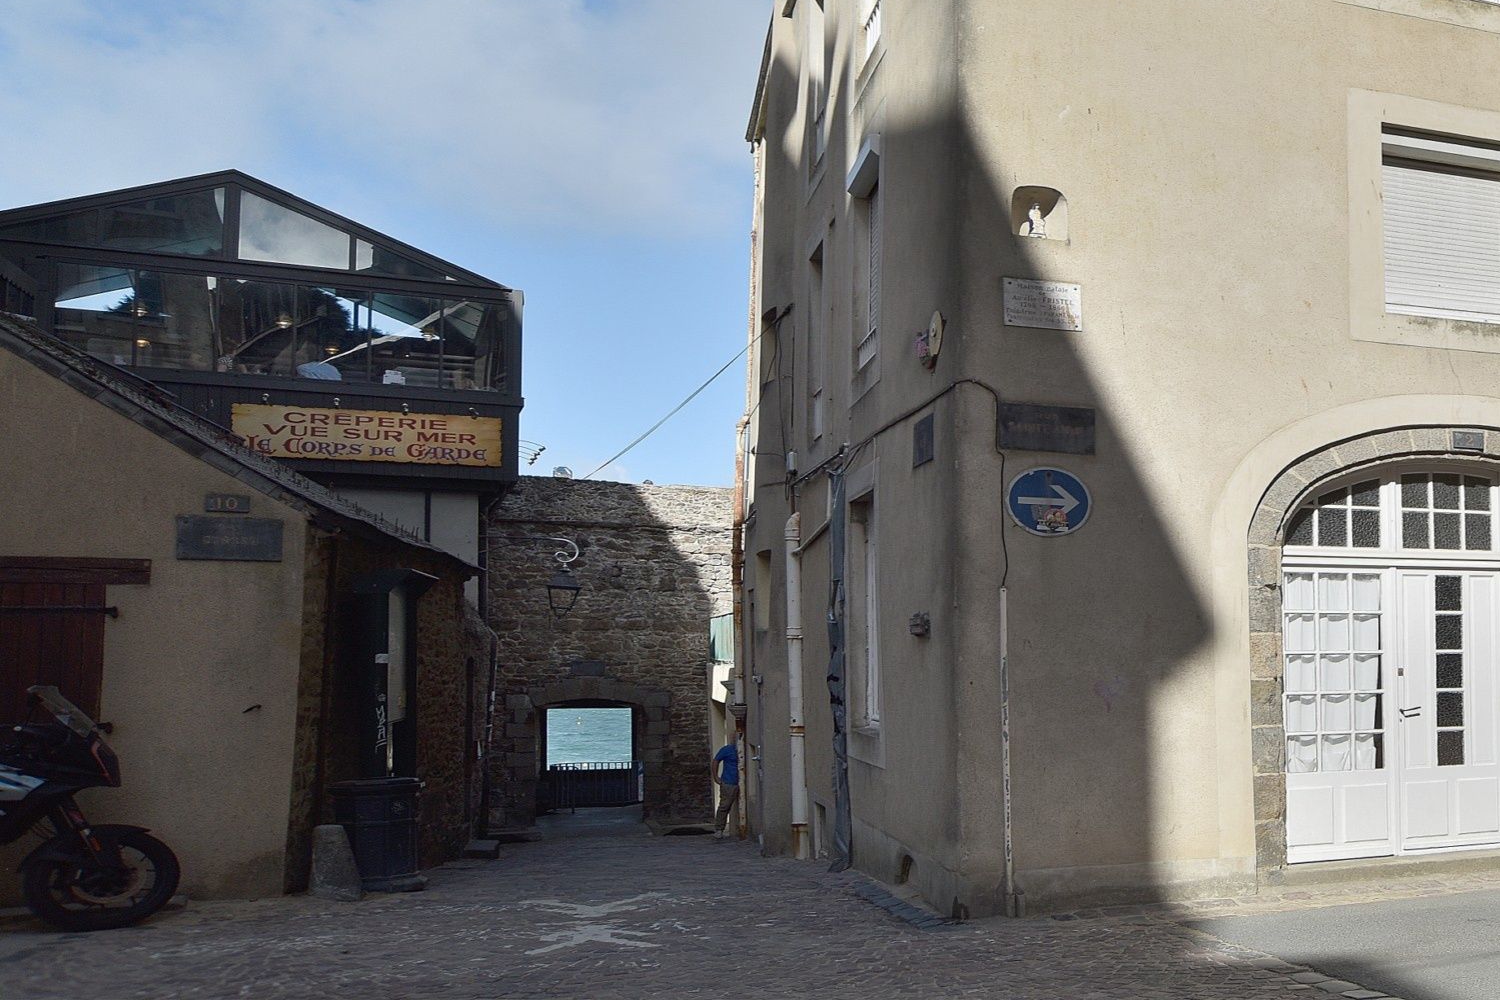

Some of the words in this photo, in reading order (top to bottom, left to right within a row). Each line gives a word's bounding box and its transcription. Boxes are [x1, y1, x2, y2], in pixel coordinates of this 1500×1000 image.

[1042, 297, 1073, 306] FRISTEL
[283, 411, 447, 430] CRÊPERIE
[263, 423, 328, 438] VUE
[343, 428, 402, 442] SUR
[416, 431, 477, 445] MER
[216, 497, 238, 509] 10
